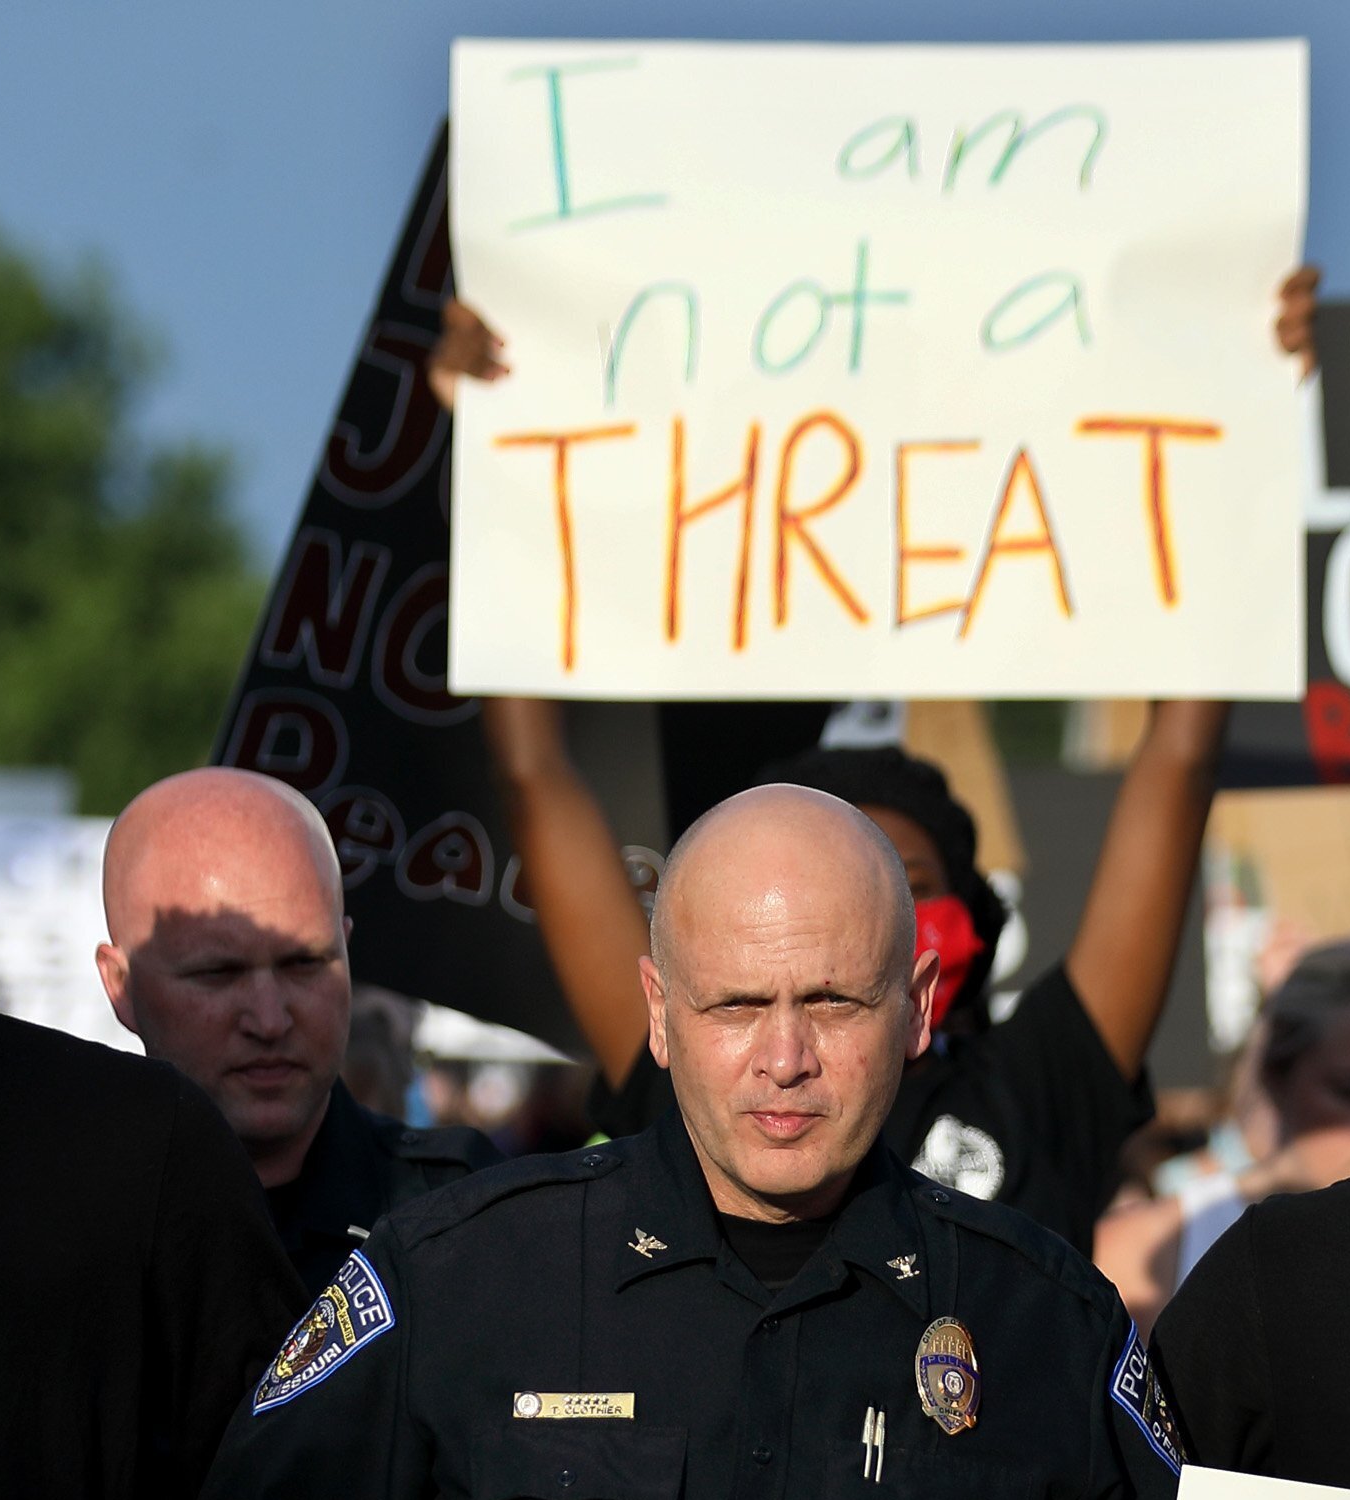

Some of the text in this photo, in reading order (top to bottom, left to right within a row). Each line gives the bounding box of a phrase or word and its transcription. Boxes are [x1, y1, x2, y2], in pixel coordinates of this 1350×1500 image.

[508, 56, 670, 231] I
[838, 104, 1109, 192] am
[597, 239, 1092, 409] not a
[492, 409, 1224, 673] THREAT
[337, 1260, 384, 1326] OLICE
[564, 1406, 623, 1415] CLOTHIER
[927, 1355, 967, 1369] POLI
